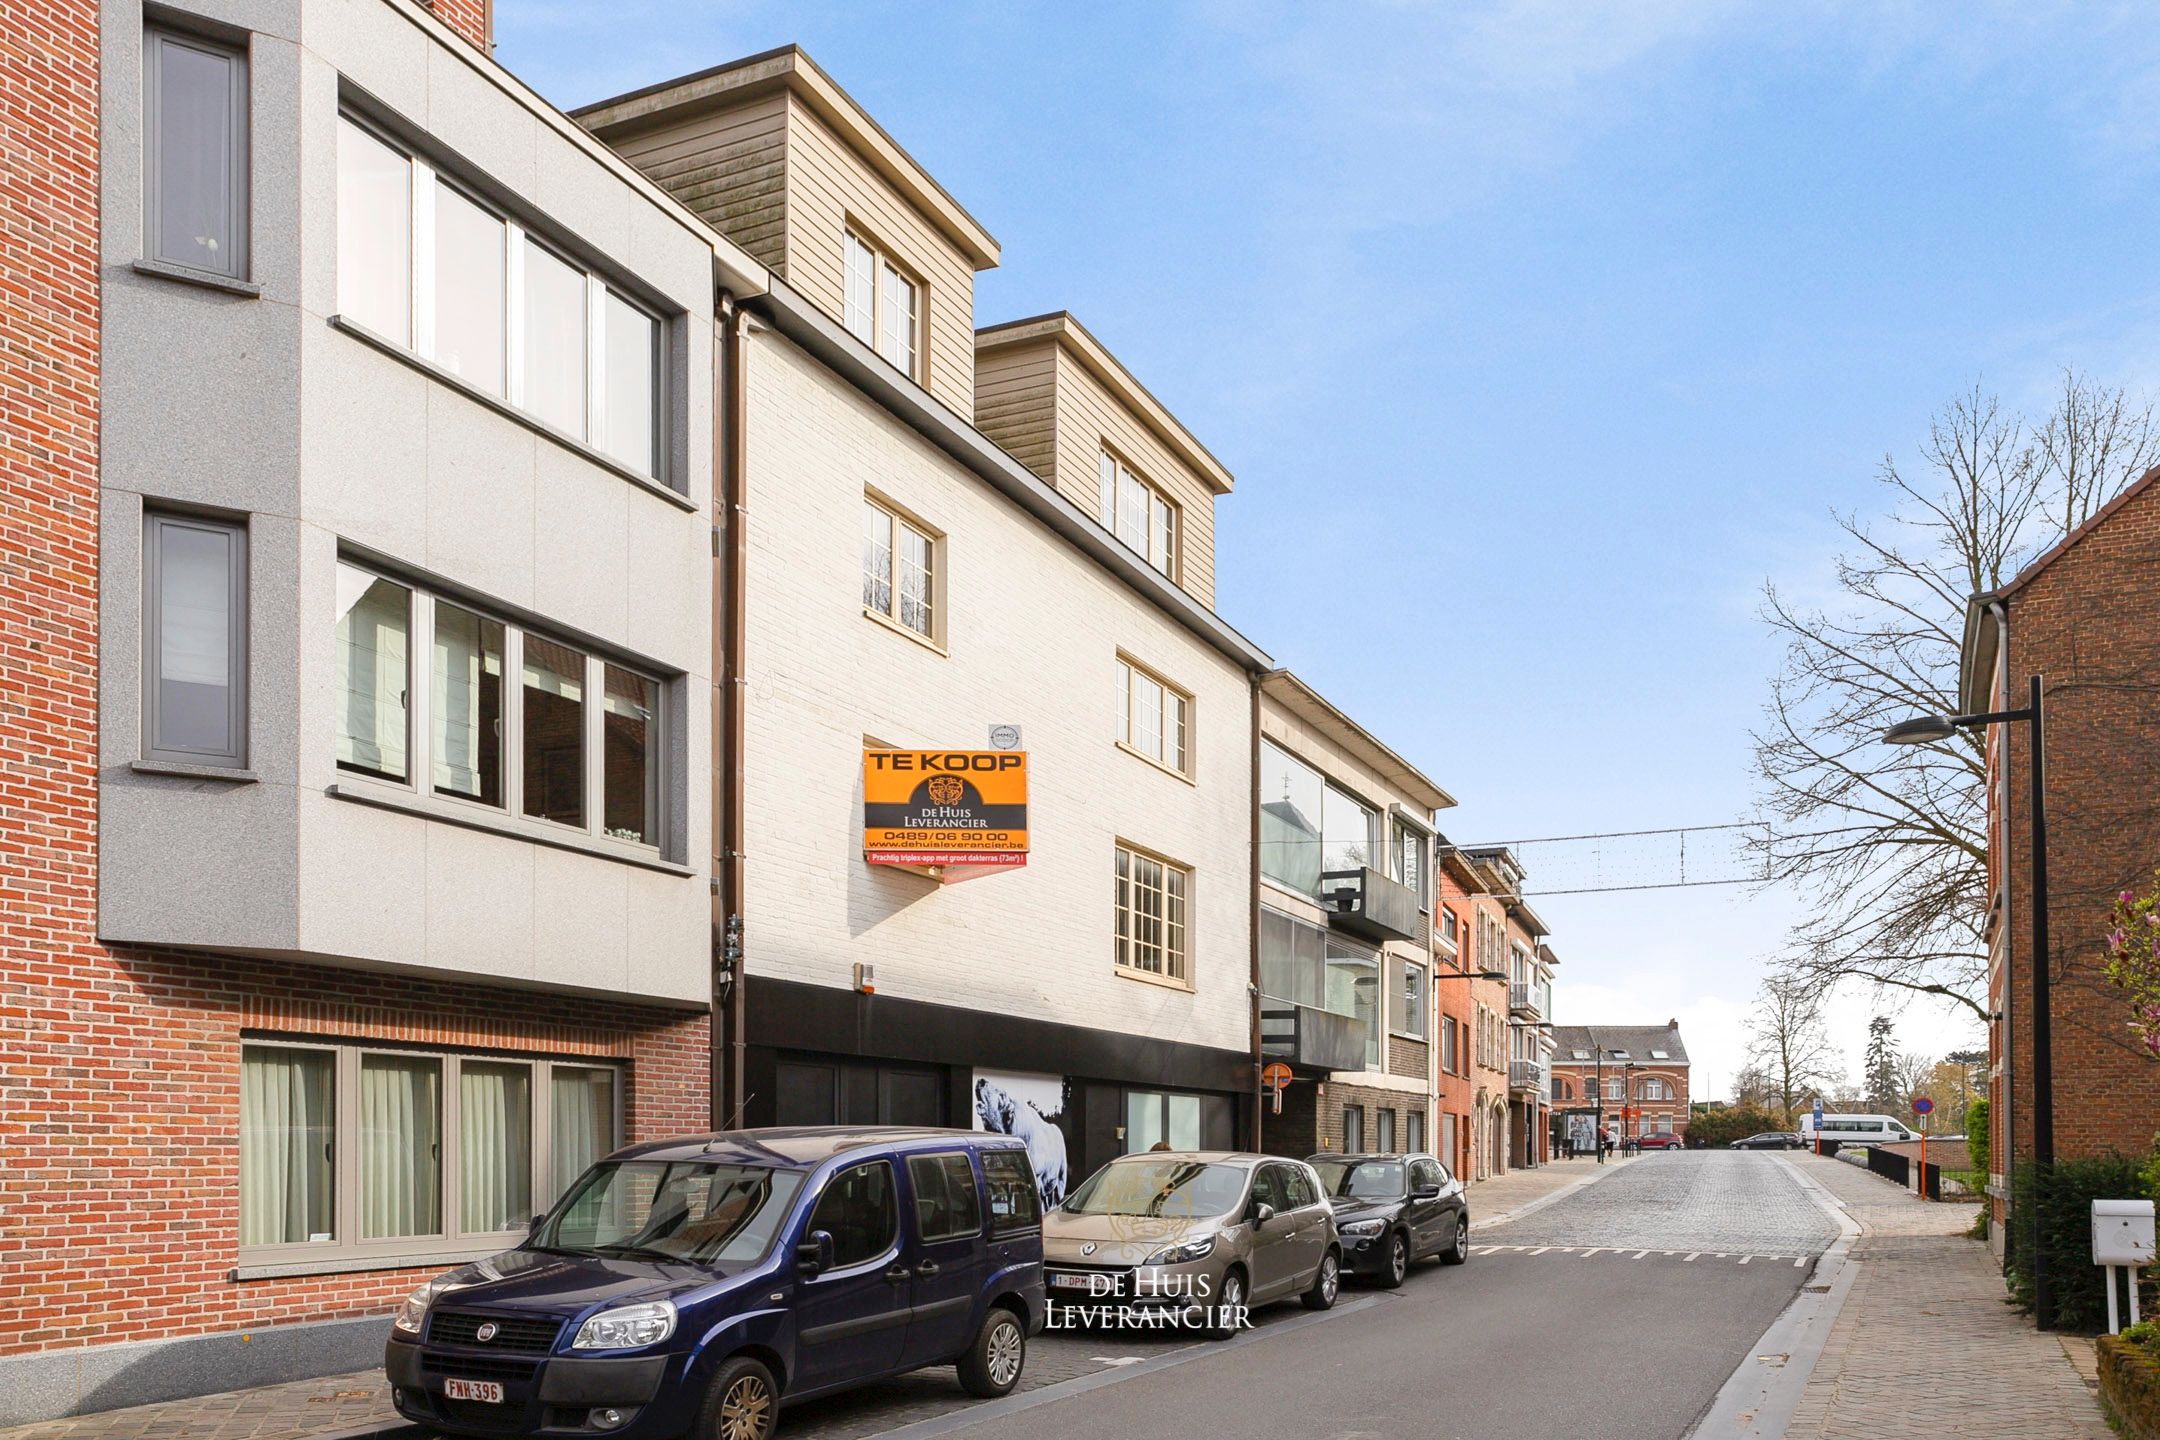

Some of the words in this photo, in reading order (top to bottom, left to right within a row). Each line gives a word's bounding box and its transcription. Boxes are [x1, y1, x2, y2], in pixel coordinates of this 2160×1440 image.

[868, 754, 913, 770] TE
[920, 754, 1022, 771] KOOP
[922, 808, 937, 818] DE
[940, 806, 972, 818] HUIS
[904, 816, 988, 828] LEVERANCIER
[884, 832, 957, 841] 0489/06
[961, 833, 982, 841] 90
[986, 833, 1008, 841] 00
[869, 841, 1023, 849] www.dehuisleverancier.be
[872, 854, 899, 862] Prachtig
[901, 854, 935, 862] triplex-app
[949, 854, 967, 863] groot
[968, 854, 998, 862] dakterras
